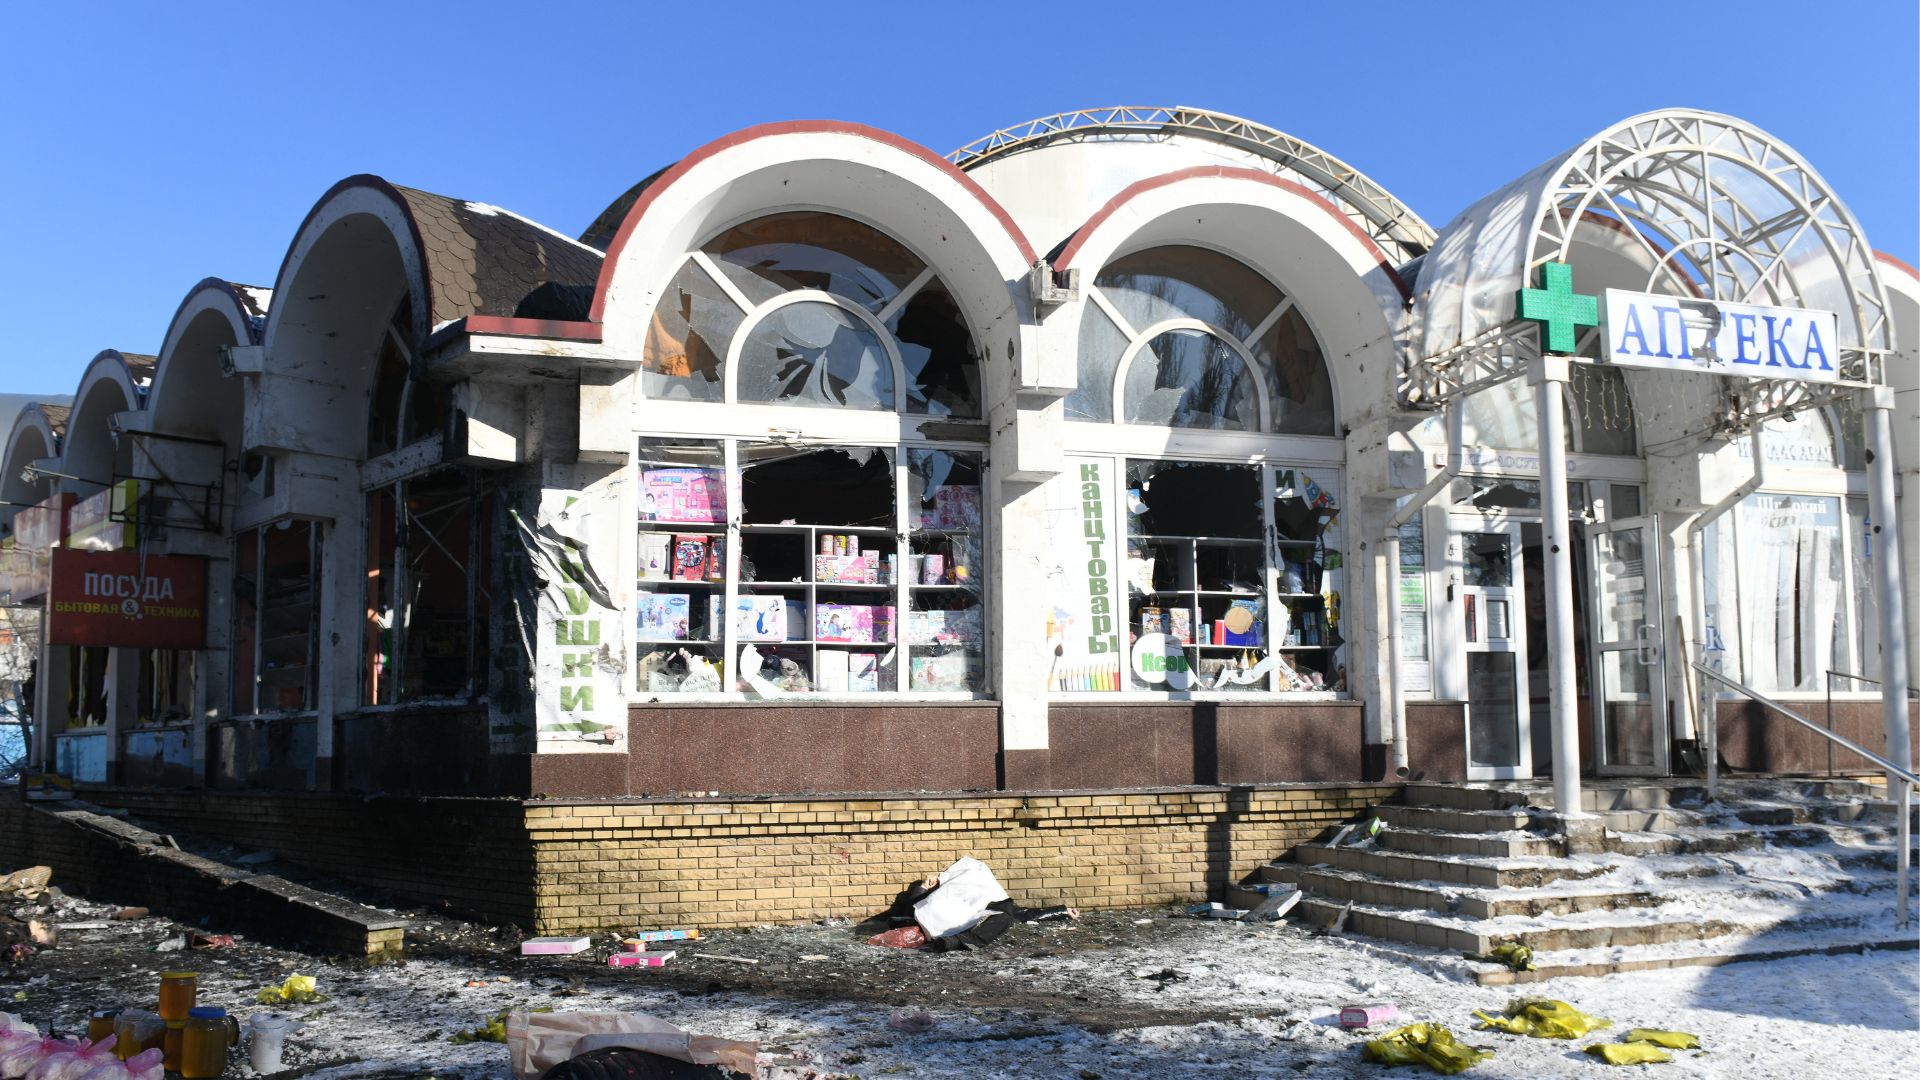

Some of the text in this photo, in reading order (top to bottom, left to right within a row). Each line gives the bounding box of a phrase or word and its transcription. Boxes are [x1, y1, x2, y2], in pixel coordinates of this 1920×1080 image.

[1756, 497, 1828, 514] Шиокий
[84, 572, 175, 603] ПОСУДА
[55, 601, 118, 614] БЫТОВАЯ
[144, 605, 200, 618] ТЕХНИКА
